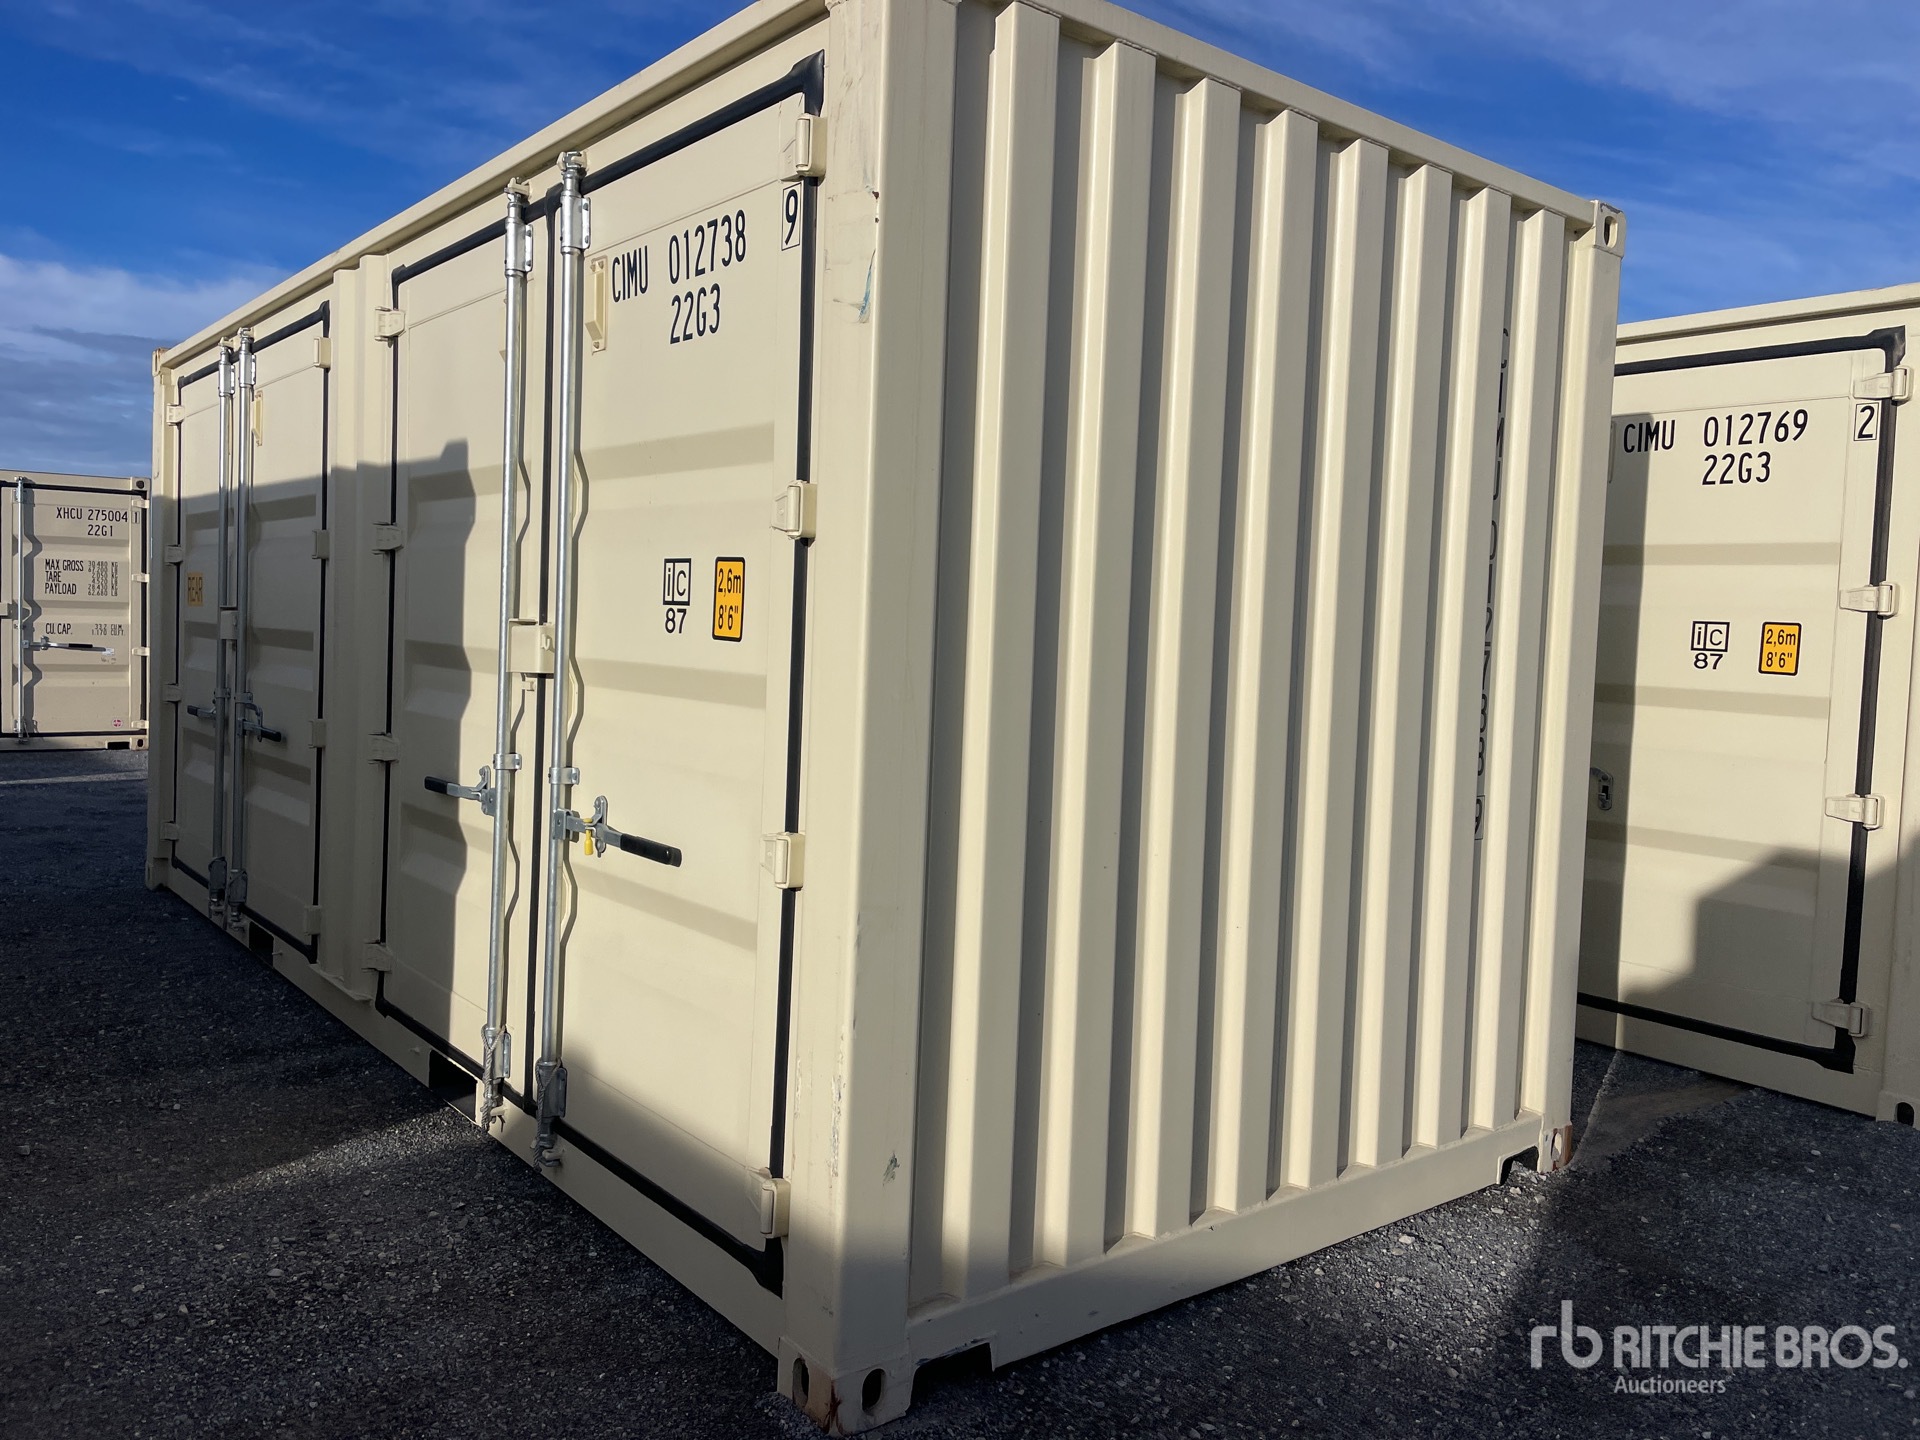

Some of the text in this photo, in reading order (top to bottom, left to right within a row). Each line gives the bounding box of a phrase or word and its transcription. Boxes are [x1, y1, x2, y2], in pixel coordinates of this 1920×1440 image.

[612, 189, 798, 302] CIMU 012738 9
[670, 283, 721, 344] 22G3
[1623, 405, 1875, 453] CIMU 012769 2
[1702, 451, 1771, 485] 22G3
[56, 507, 83, 520] XHCU
[87, 509, 128, 522] 275004
[87, 524, 113, 537] 22G1
[45, 559, 60, 570] MAX
[62, 560, 84, 571] GROSS
[45, 571, 62, 582] TARE
[717, 568, 742, 597] 2,6m
[45, 583, 77, 595] PAYLOAD
[665, 607, 687, 634] 87
[717, 604, 739, 630] 8'6"
[57, 623, 73, 635] CAP.
[1765, 628, 1796, 647] 2,6m
[1694, 652, 1723, 669] 87
[1766, 652, 1792, 668] 8'6"
